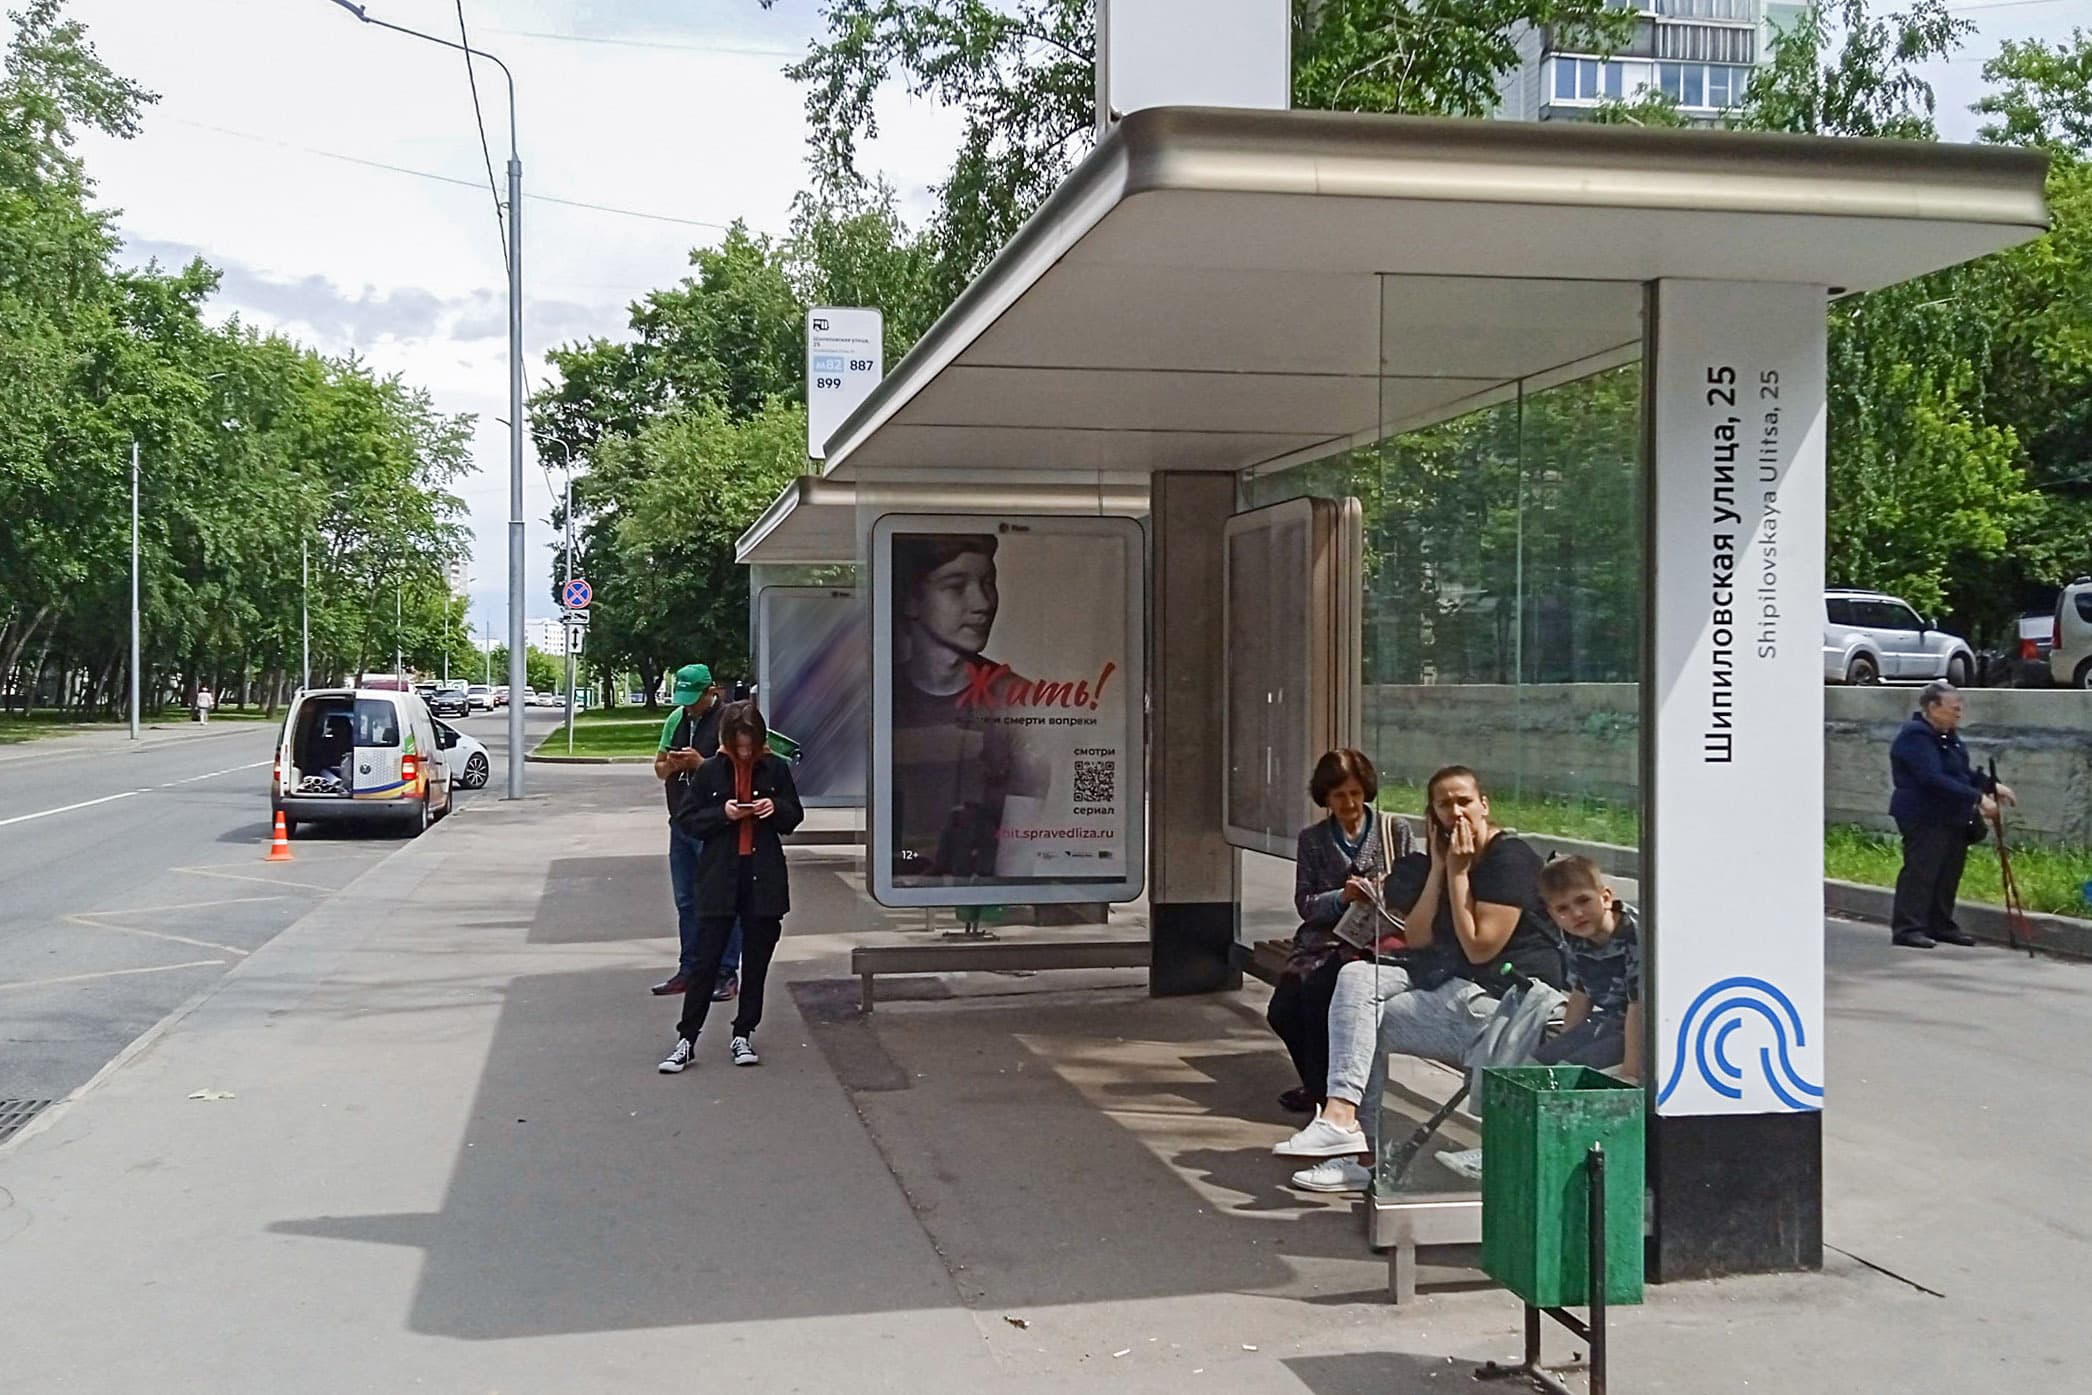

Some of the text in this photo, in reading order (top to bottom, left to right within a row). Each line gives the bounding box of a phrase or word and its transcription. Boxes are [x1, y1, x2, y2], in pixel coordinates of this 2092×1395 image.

[849, 360, 874, 371] 887
[816, 377, 842, 389] 899
[1757, 370, 1781, 659] Shipilovskaya Ulitsa, 25
[1704, 366, 1741, 763] Шипиловская улица, 25
[955, 662, 1116, 711] Жить!
[1003, 716, 1046, 726] смерти
[1048, 716, 1097, 727] вопреки
[1073, 747, 1116, 757] смотри
[1073, 806, 1115, 816] сериал
[994, 826, 1115, 840] hit.spravedliza.ru
[901, 849, 920, 860] 12+
